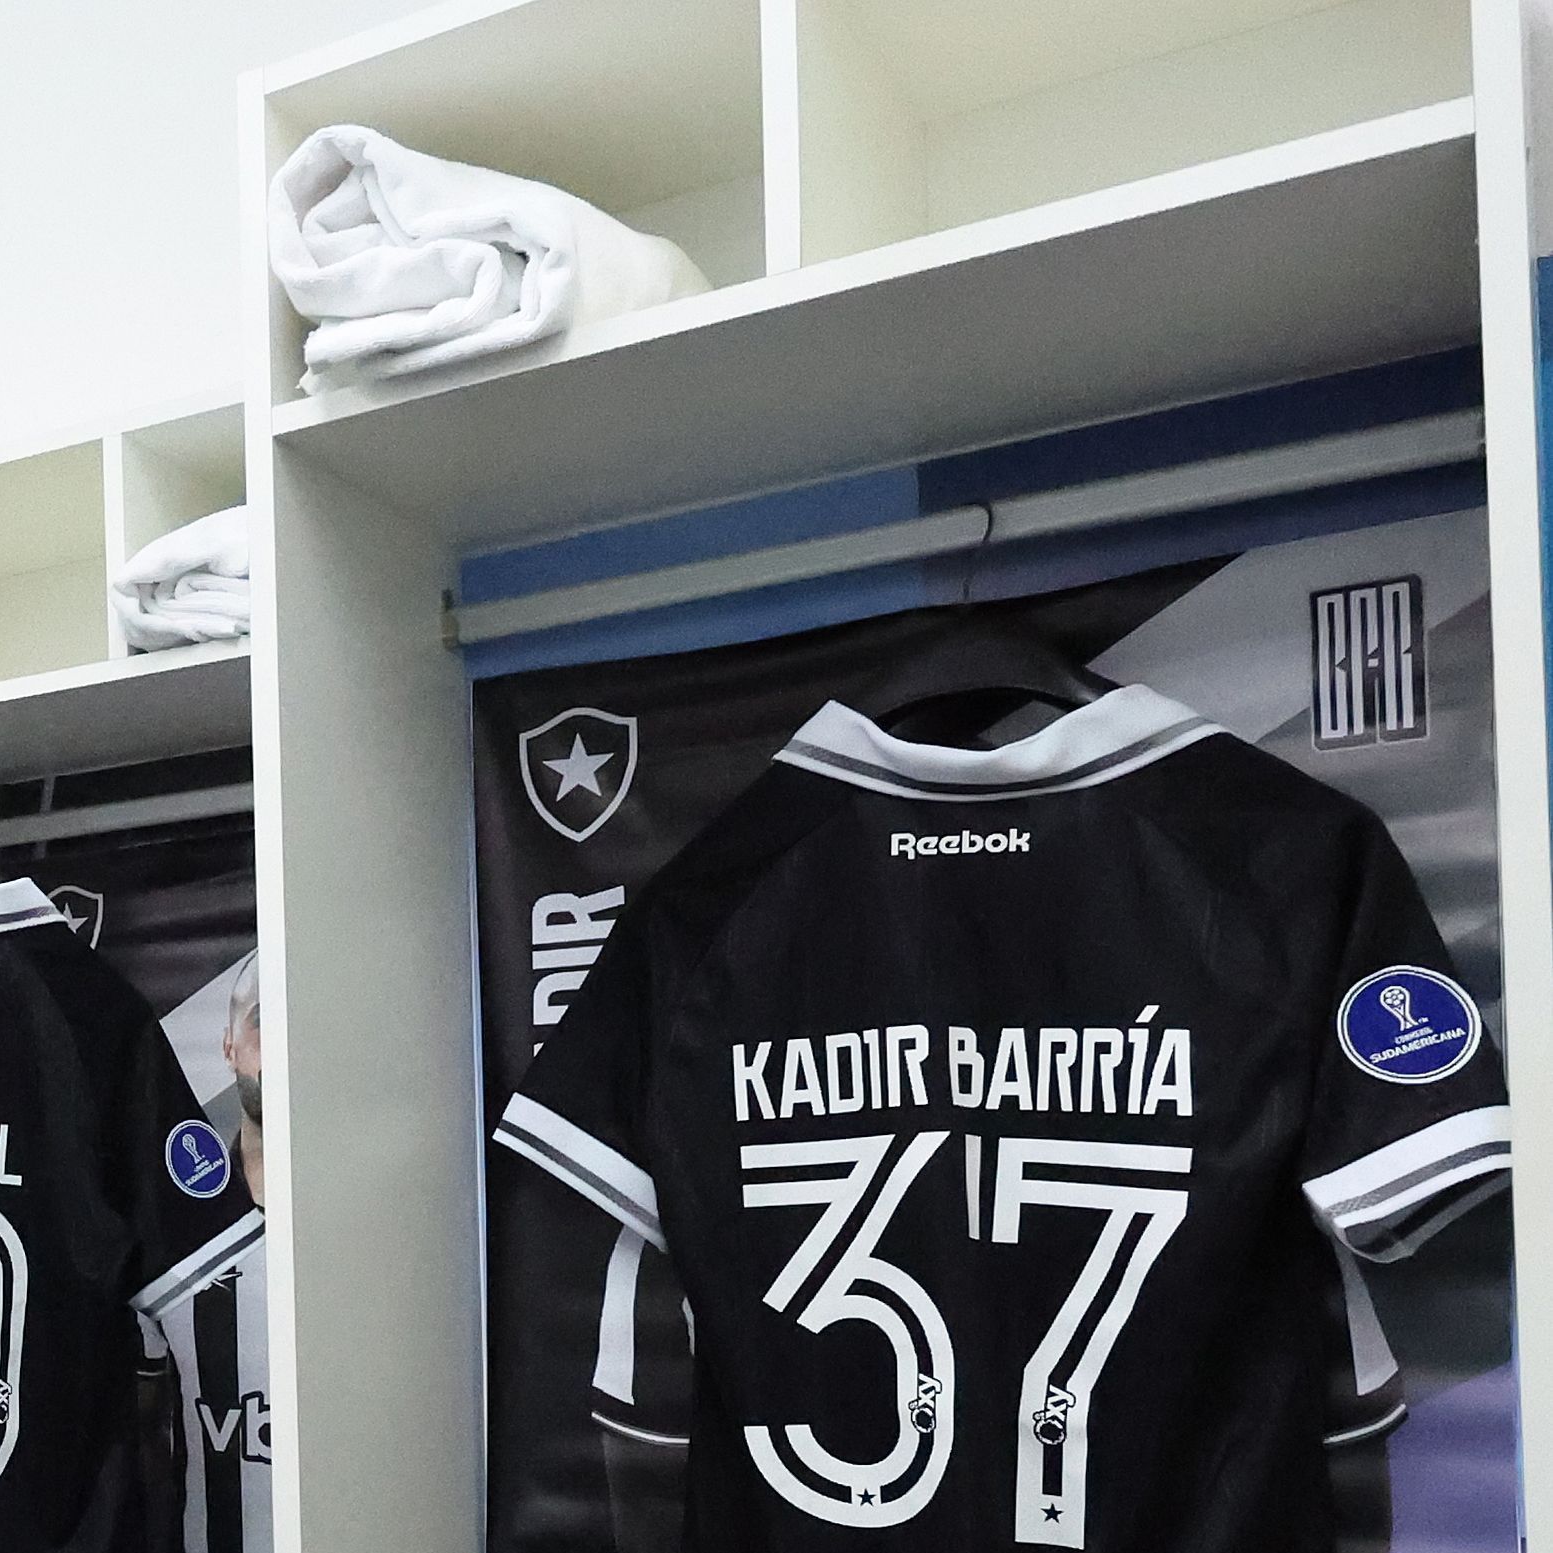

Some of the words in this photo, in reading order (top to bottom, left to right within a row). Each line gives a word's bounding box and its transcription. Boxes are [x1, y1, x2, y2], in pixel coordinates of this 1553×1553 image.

[890, 828, 1031, 860] Reebok
[532, 885, 625, 1058] DIR
[732, 1025, 930, 1122] KADIR
[949, 1005, 1193, 1117] BARRÍA
[1369, 1026, 1466, 1064] SUDAMERICANA
[739, 1130, 1194, 1551] 37
